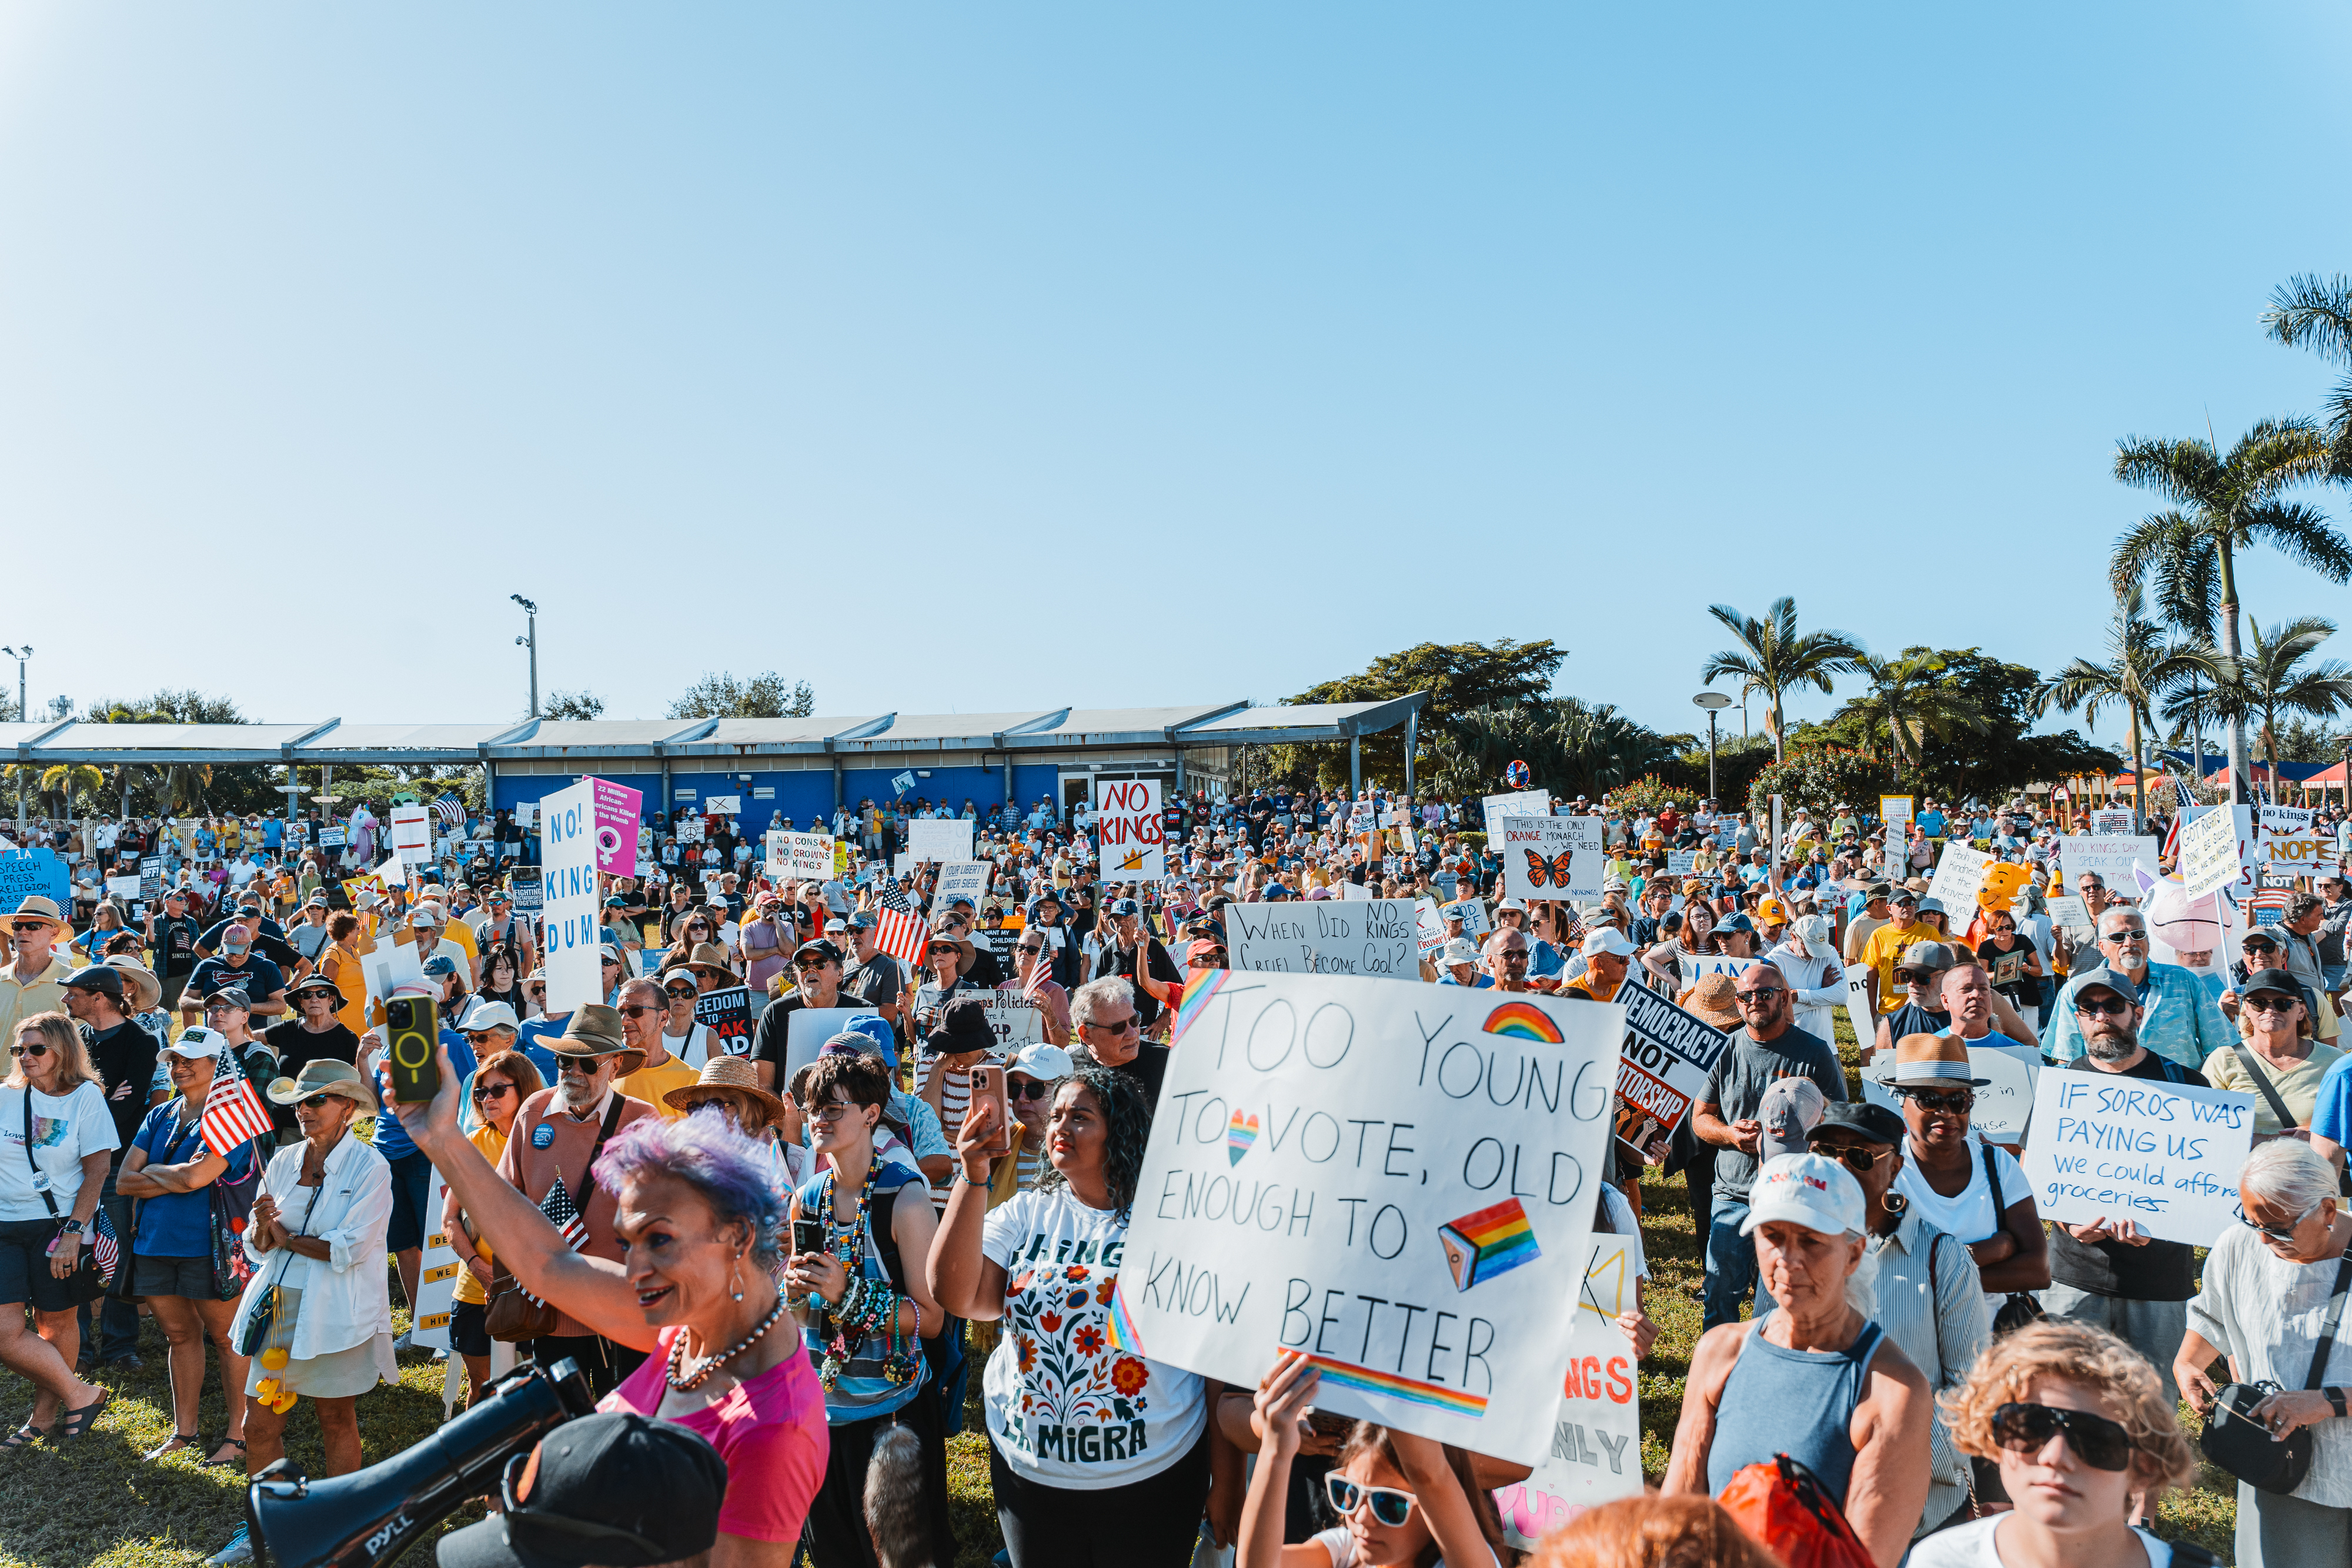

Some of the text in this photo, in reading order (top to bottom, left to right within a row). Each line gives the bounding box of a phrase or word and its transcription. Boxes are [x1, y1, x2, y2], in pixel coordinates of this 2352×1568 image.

[607, 787, 628, 799] Million
[1103, 782, 1150, 812] NO
[599, 794, 624, 806] African-
[599, 811, 629, 825] the Womb
[619, 808, 636, 819] Killed
[2262, 808, 2309, 822] no kings
[551, 803, 582, 844] NO!
[1099, 813, 1163, 846] KINGS
[1512, 819, 1586, 831] THIS IS THE ONLY
[2181, 810, 2220, 847] GOT RIGHTS
[290, 833, 309, 841] KINGS
[1506, 830, 1584, 842] ORANGE MONARCH
[1889, 827, 1903, 836] DEFEND
[777, 835, 818, 847] NO CONS
[1561, 841, 1599, 851] WE NEED
[2069, 842, 2140, 853] NO KINGS DAY
[2203, 838, 2211, 851] BE
[15, 849, 32, 860] 1A
[777, 848, 830, 860] NO CROWNS
[1887, 849, 1904, 858] PRESIDENT
[1953, 848, 1970, 862] Pooh
[0, 861, 41, 874] SPEECH
[142, 859, 160, 868] HANDS
[793, 860, 822, 870] KINGS
[2078, 856, 2139, 867] SPEAK OUT
[2186, 854, 2216, 879] WE ARE THE
[142, 866, 159, 878] OFF!
[945, 865, 987, 876] YOUR LIBERTY
[1947, 860, 1983, 878] Kindness
[4, 872, 35, 884] PRESS
[546, 864, 593, 901] KING
[943, 878, 980, 890] UNDER SIEGE
[1943, 873, 1972, 888] is the
[2188, 859, 2237, 896] STAND TOGETHER AS ONE
[2262, 877, 2293, 887] NOT
[0, 882, 51, 894] RELIGION
[1563, 888, 1598, 897] #NOKINGS
[1939, 884, 1973, 902] bravest
[1112, 900, 1127, 911] NAVY
[1956, 904, 1971, 916] you
[1367, 901, 1398, 924] NO
[1233, 904, 1349, 941] WHEN DID
[547, 914, 593, 953] DUM
[1366, 920, 1409, 940] KINGS
[1417, 929, 1441, 942] KINGS
[231, 934, 238, 943] B
[1418, 933, 1448, 950] TRUMP!
[1301, 942, 1406, 975] BECOME COOL?
[1695, 962, 1700, 984] I
[995, 989, 1034, 1010] Policies
[706, 1013, 719, 1024] TO
[985, 1009, 1007, 1020] Are A
[1621, 984, 1723, 1079] DEMOCRACY NOT
[1008, 1037, 1020, 1049] In
[1211, 984, 1607, 1122] TOO YOUNG
[2000, 1085, 2015, 1097] in
[2059, 1082, 2247, 1129] IF SOROS WAS
[4, 1129, 25, 1141] Love
[2057, 1117, 2209, 1161] PAYING US
[1172, 1089, 1582, 1205] TO VOTE, OLD
[2096, 1162, 2165, 1186] could
[2043, 1182, 2170, 1213] groceries.
[1157, 1169, 1408, 1261] ENOUGH TO
[436, 1268, 451, 1278] WE
[430, 1315, 449, 1326] HIM
[1141, 1250, 1495, 1395] KNOW BETTER
[1563, 1355, 1633, 1405] NGS
[1551, 1420, 1629, 1475] NLY
